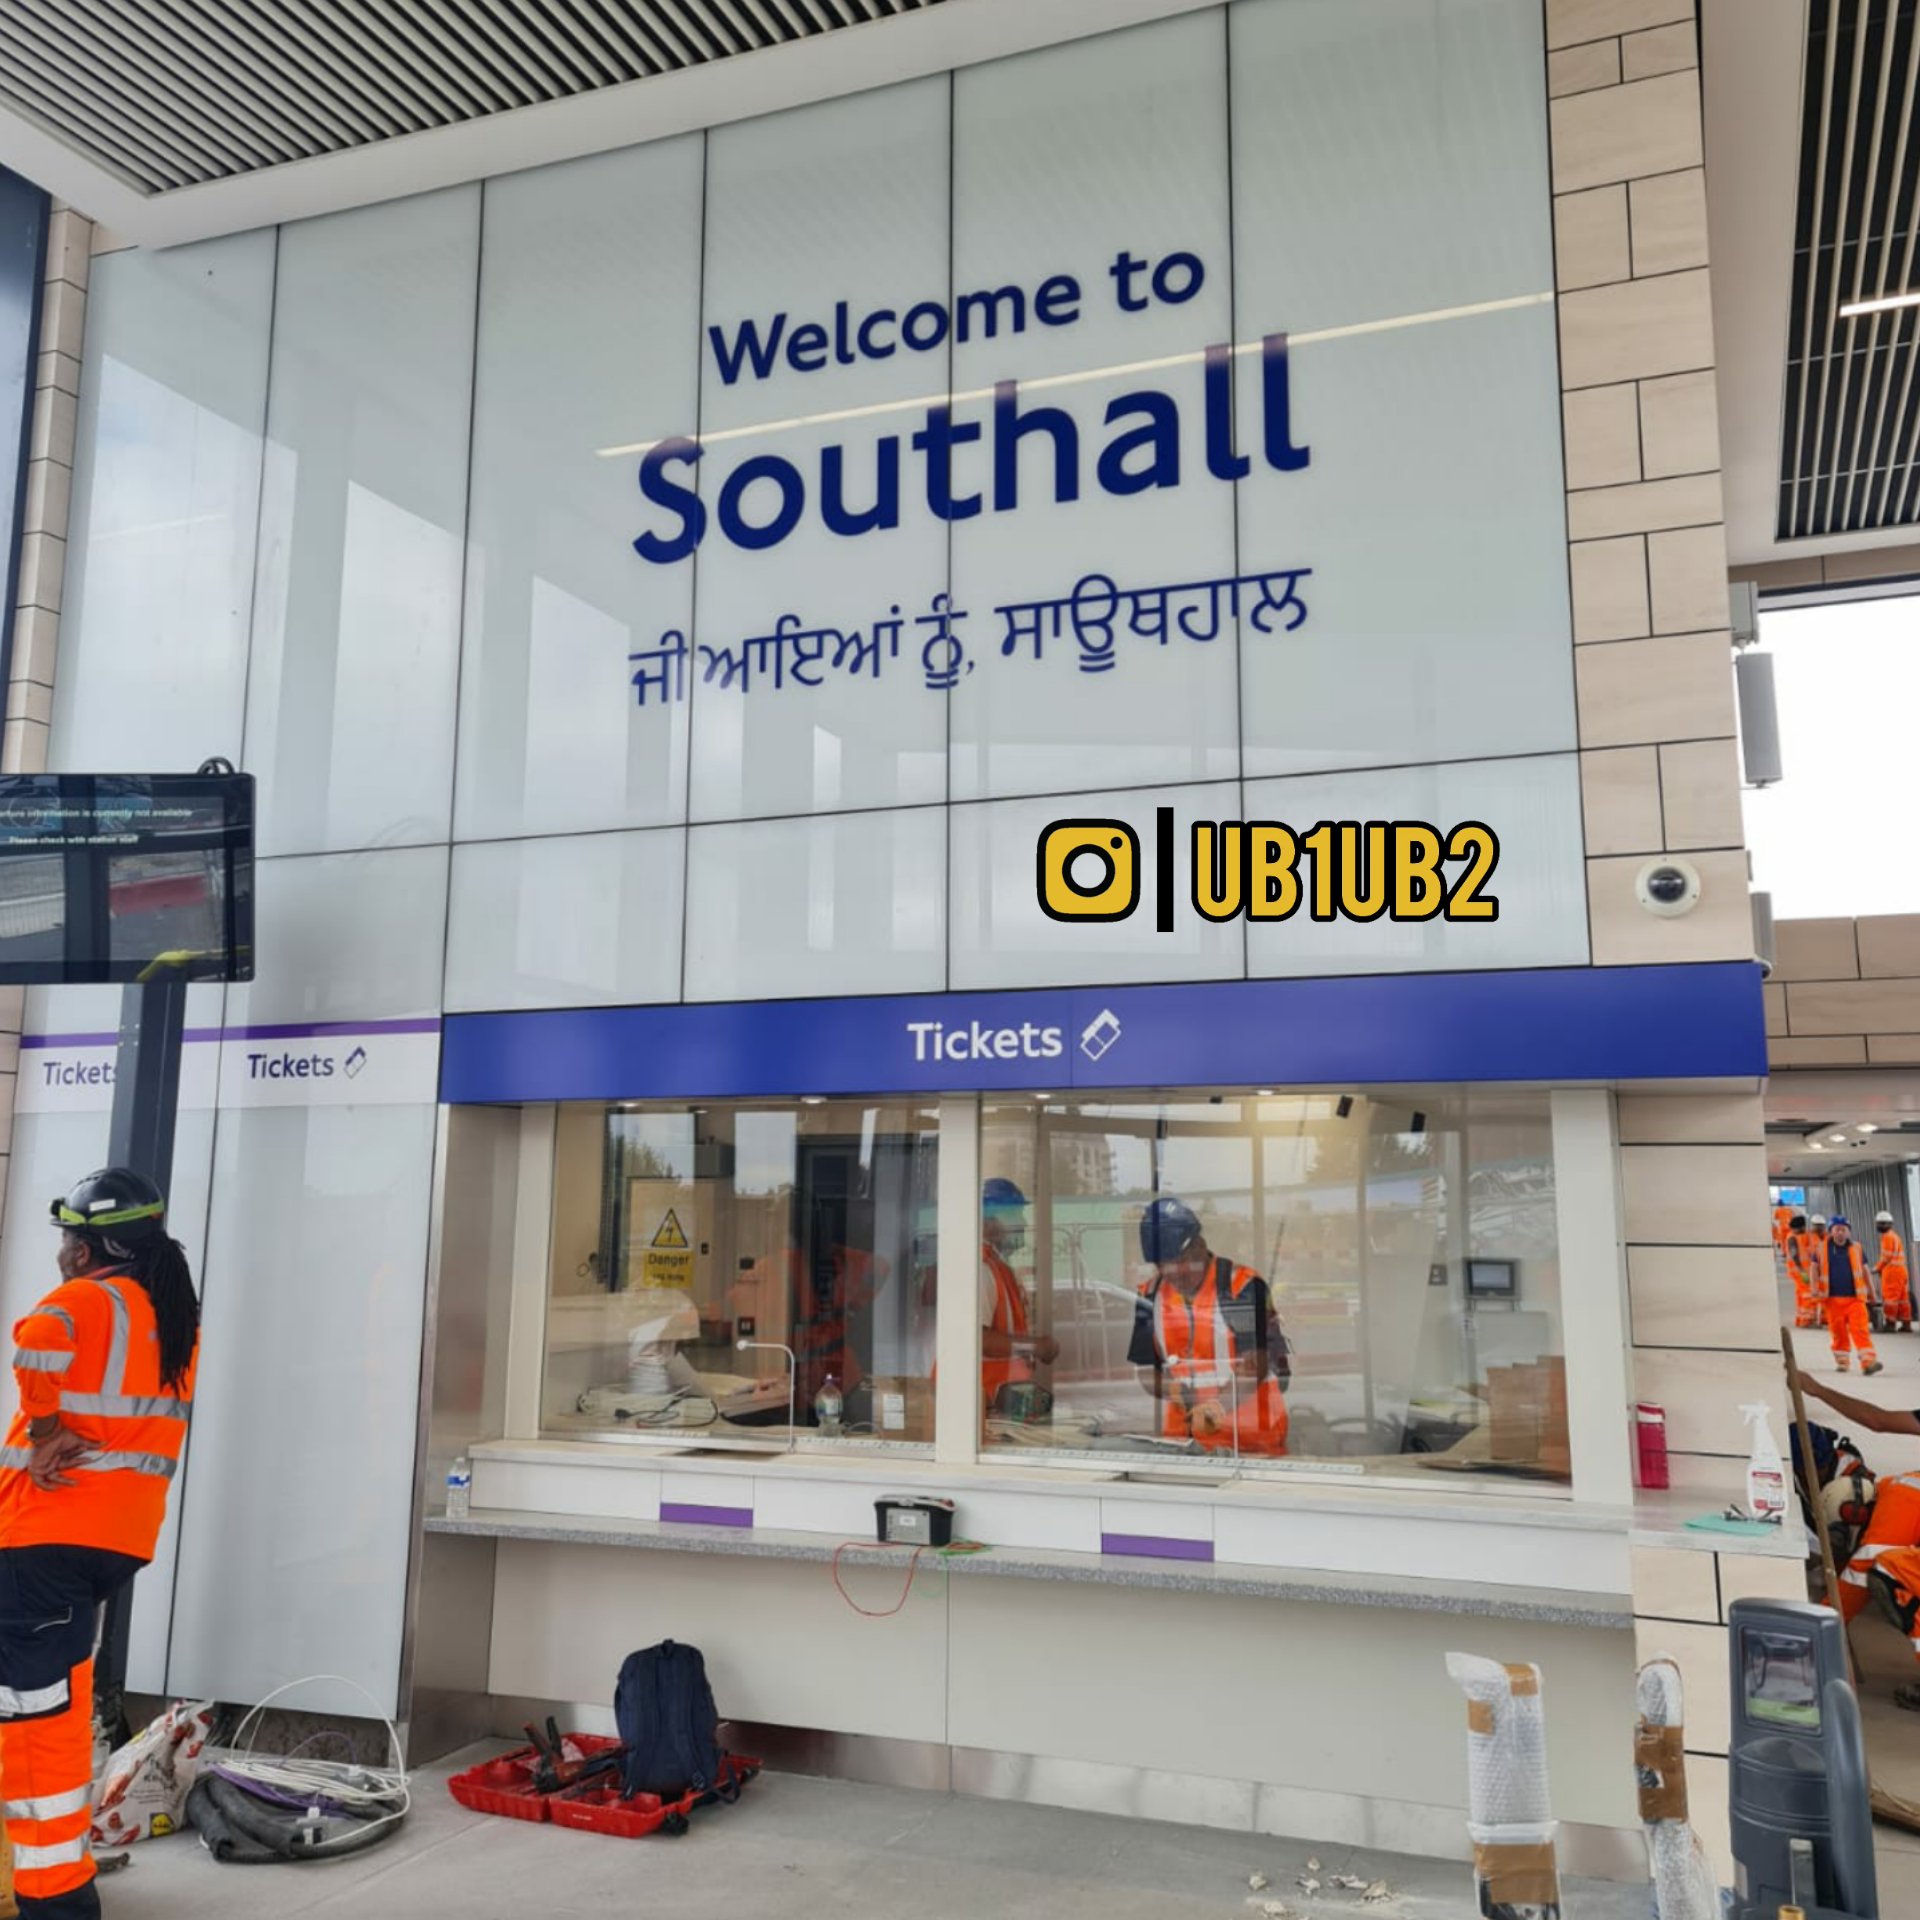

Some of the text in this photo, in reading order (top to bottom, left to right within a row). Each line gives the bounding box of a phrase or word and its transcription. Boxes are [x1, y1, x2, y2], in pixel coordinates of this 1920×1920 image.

[709, 251, 1204, 386] Welcome to
[632, 332, 1310, 565] Southall
[629, 630, 689, 706] ਜੀ
[698, 604, 905, 694] ਆਇਆਂ
[995, 568, 1311, 674] ਸਾਊਥਹਾਲ
[247, 1054, 335, 1079] Tickets
[906, 1021, 1064, 1062] Tickets
[648, 1254, 690, 1267] Danger
